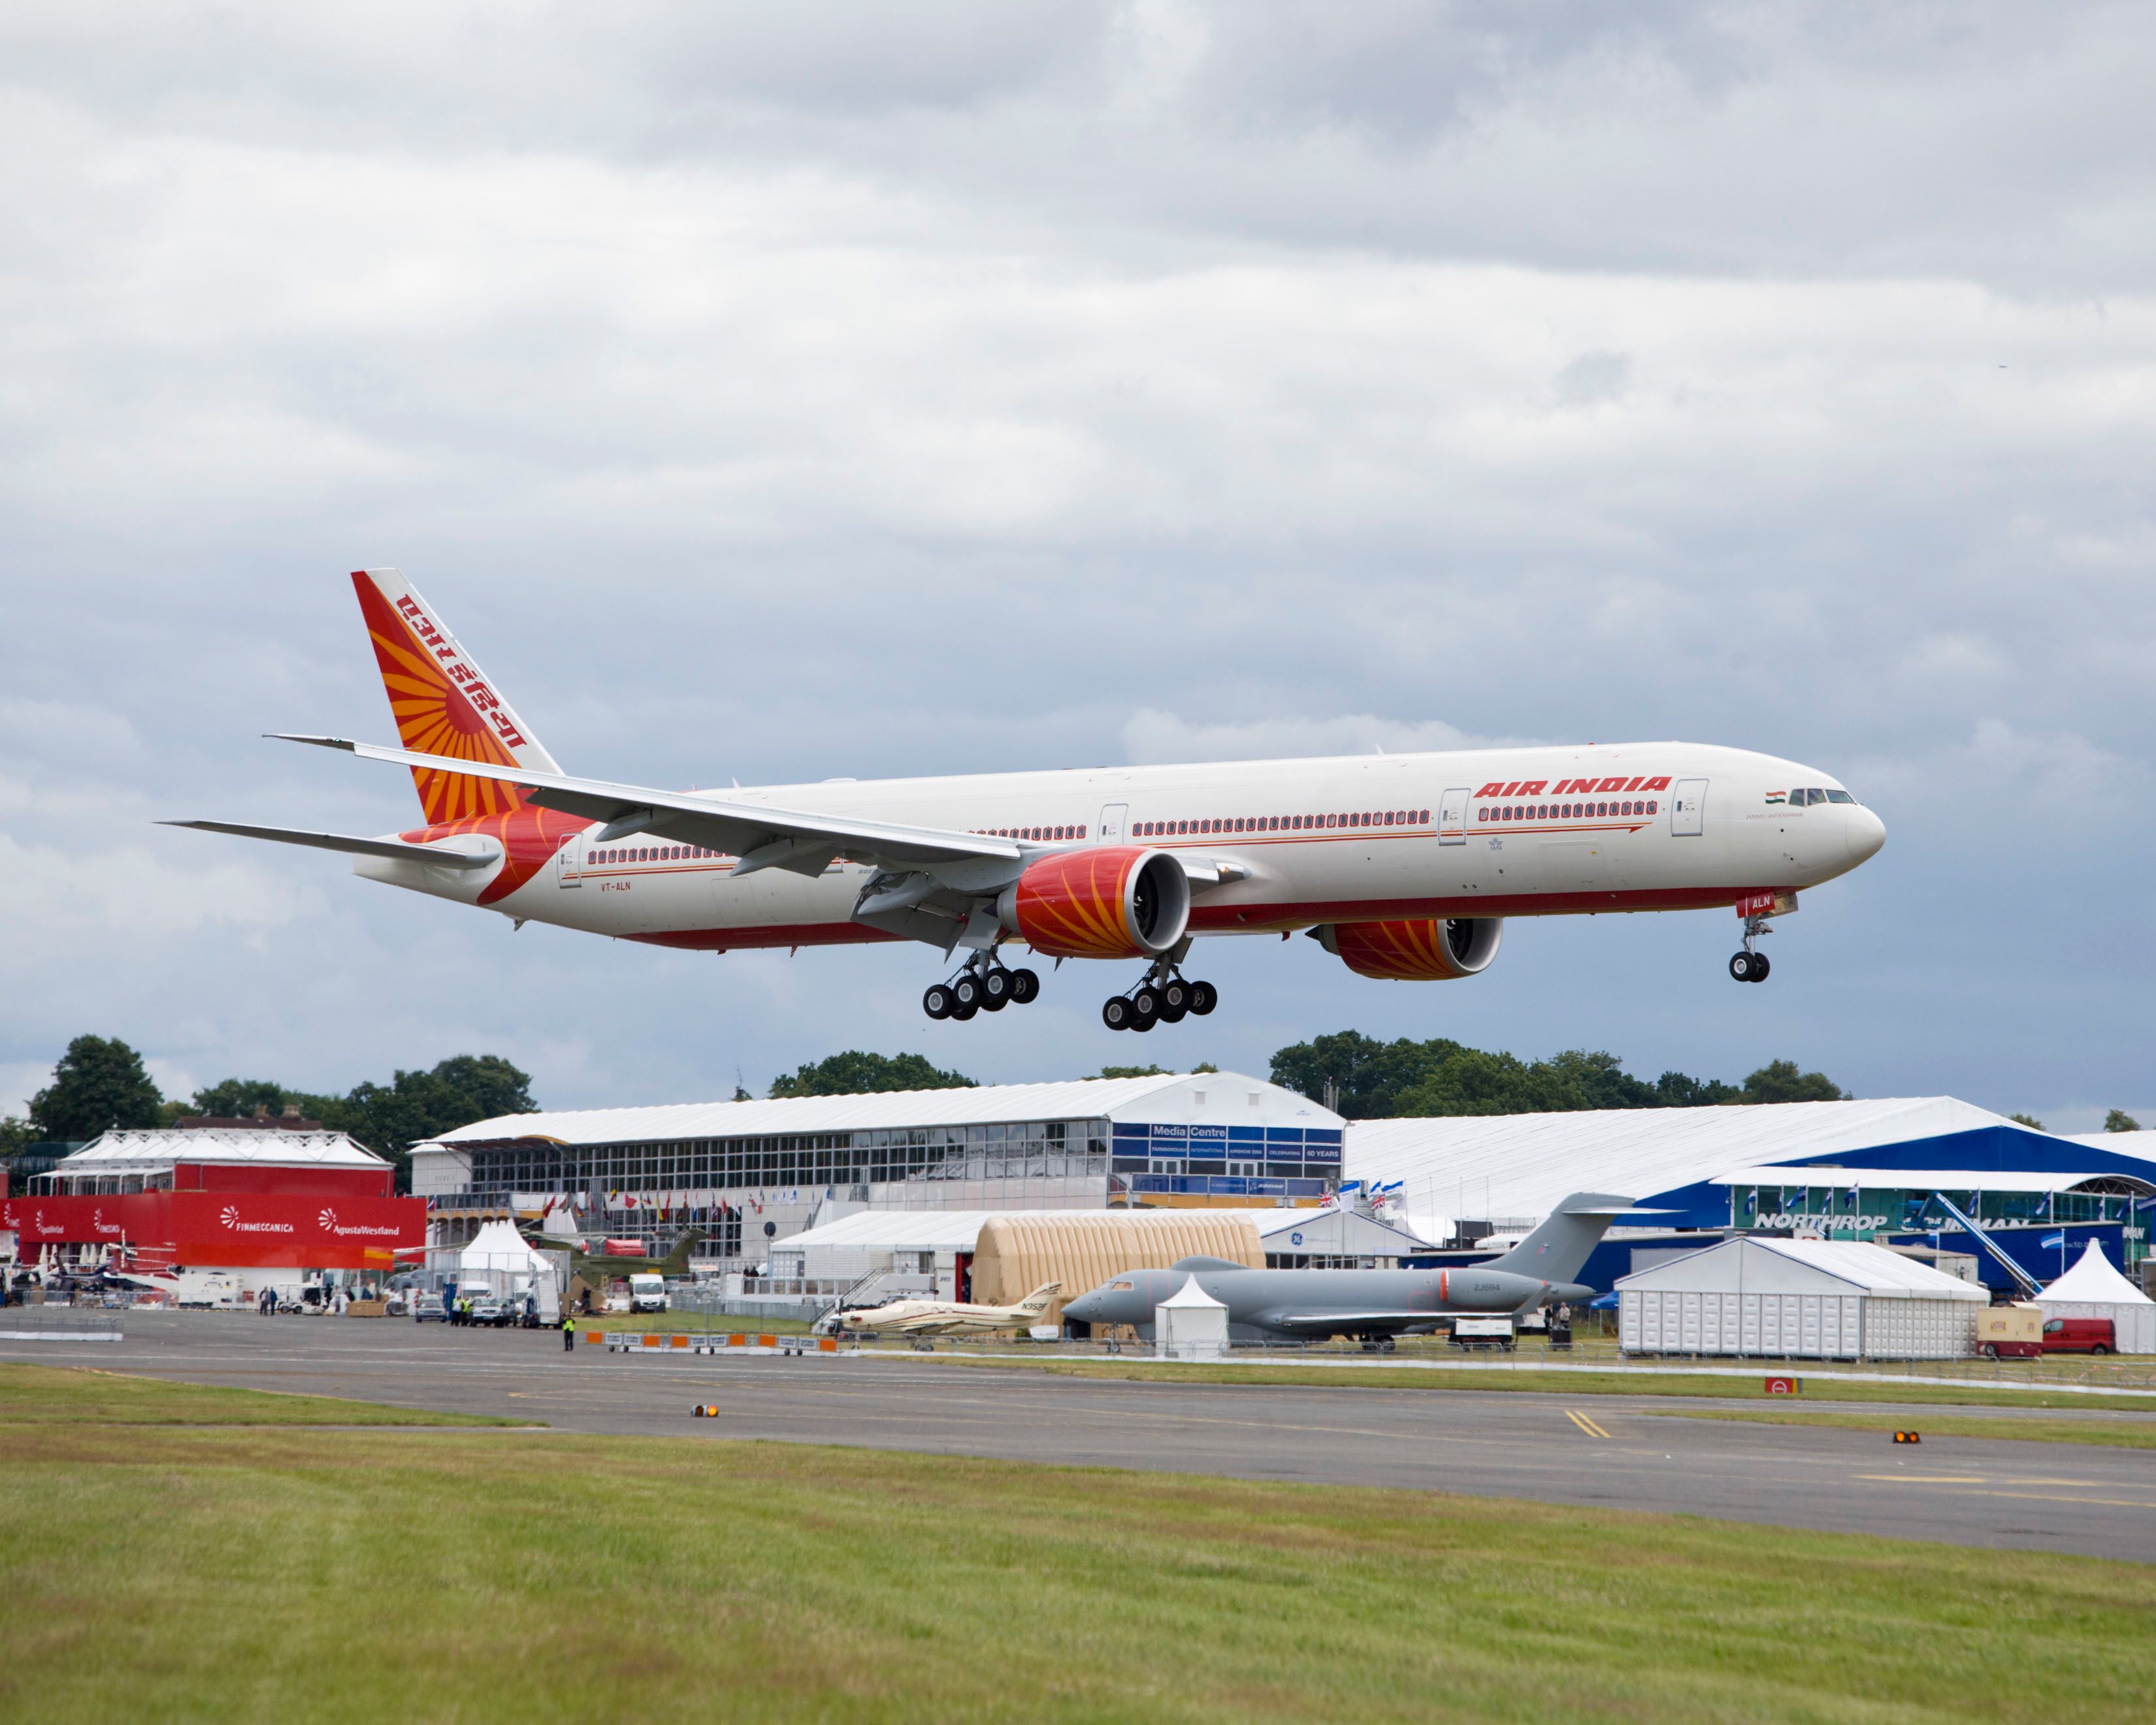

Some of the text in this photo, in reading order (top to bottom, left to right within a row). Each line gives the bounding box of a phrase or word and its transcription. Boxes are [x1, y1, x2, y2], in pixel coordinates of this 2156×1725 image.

[1473, 776, 1673, 798] AIR INDIA
[600, 881, 631, 892] VT-ALN
[1752, 896, 1771, 909] ALN
[1153, 1125, 1226, 1138] Media Centre
[1754, 1213, 1888, 1230] NORTHROP
[236, 1223, 399, 1236] FINMECCANICA AgustaWestland
[1474, 1283, 1500, 1292] ZJ694
